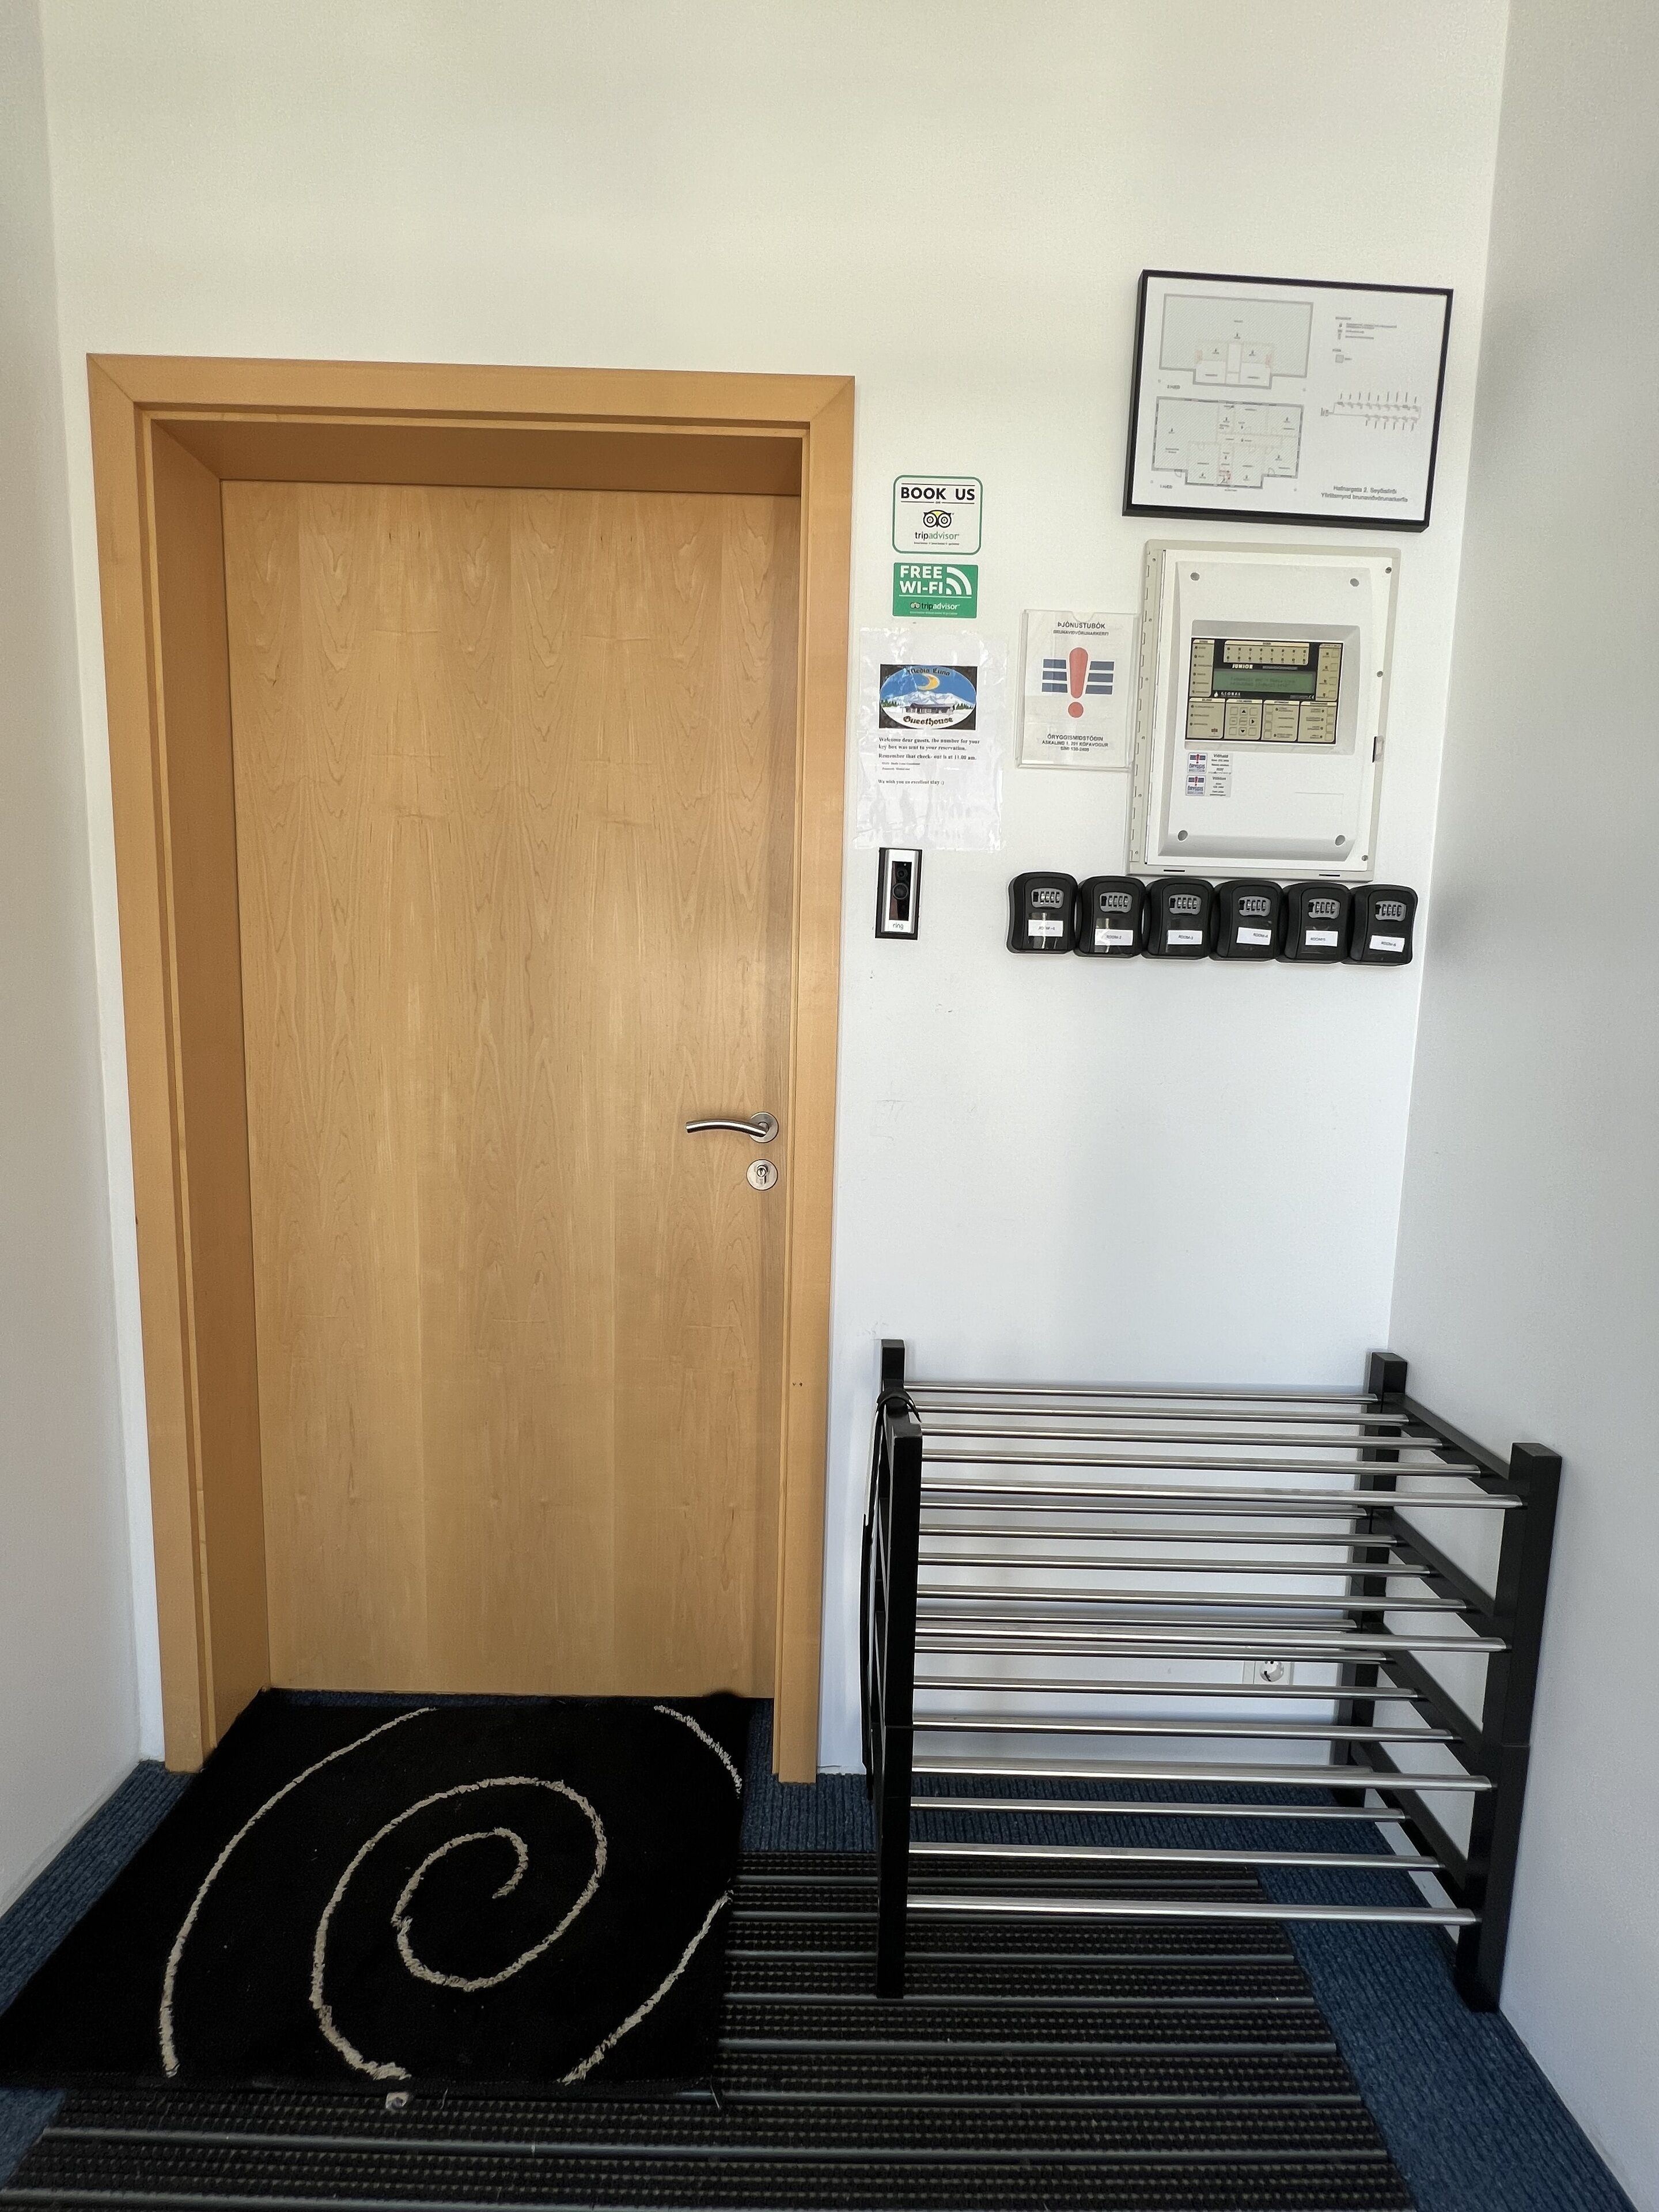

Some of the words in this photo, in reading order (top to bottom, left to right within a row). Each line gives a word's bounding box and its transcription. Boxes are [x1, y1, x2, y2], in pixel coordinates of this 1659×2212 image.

[901, 487, 946, 500] BOOK
[956, 488, 975, 501] US
[915, 531, 957, 541] tripadvisor
[900, 565, 942, 578] FREE
[900, 581, 943, 594] WI-FI
[921, 603, 958, 611] tripadvisor
[1057, 621, 1105, 629] ÞJÓNUSTUBÓK
[903, 715, 953, 726] Guesthouse
